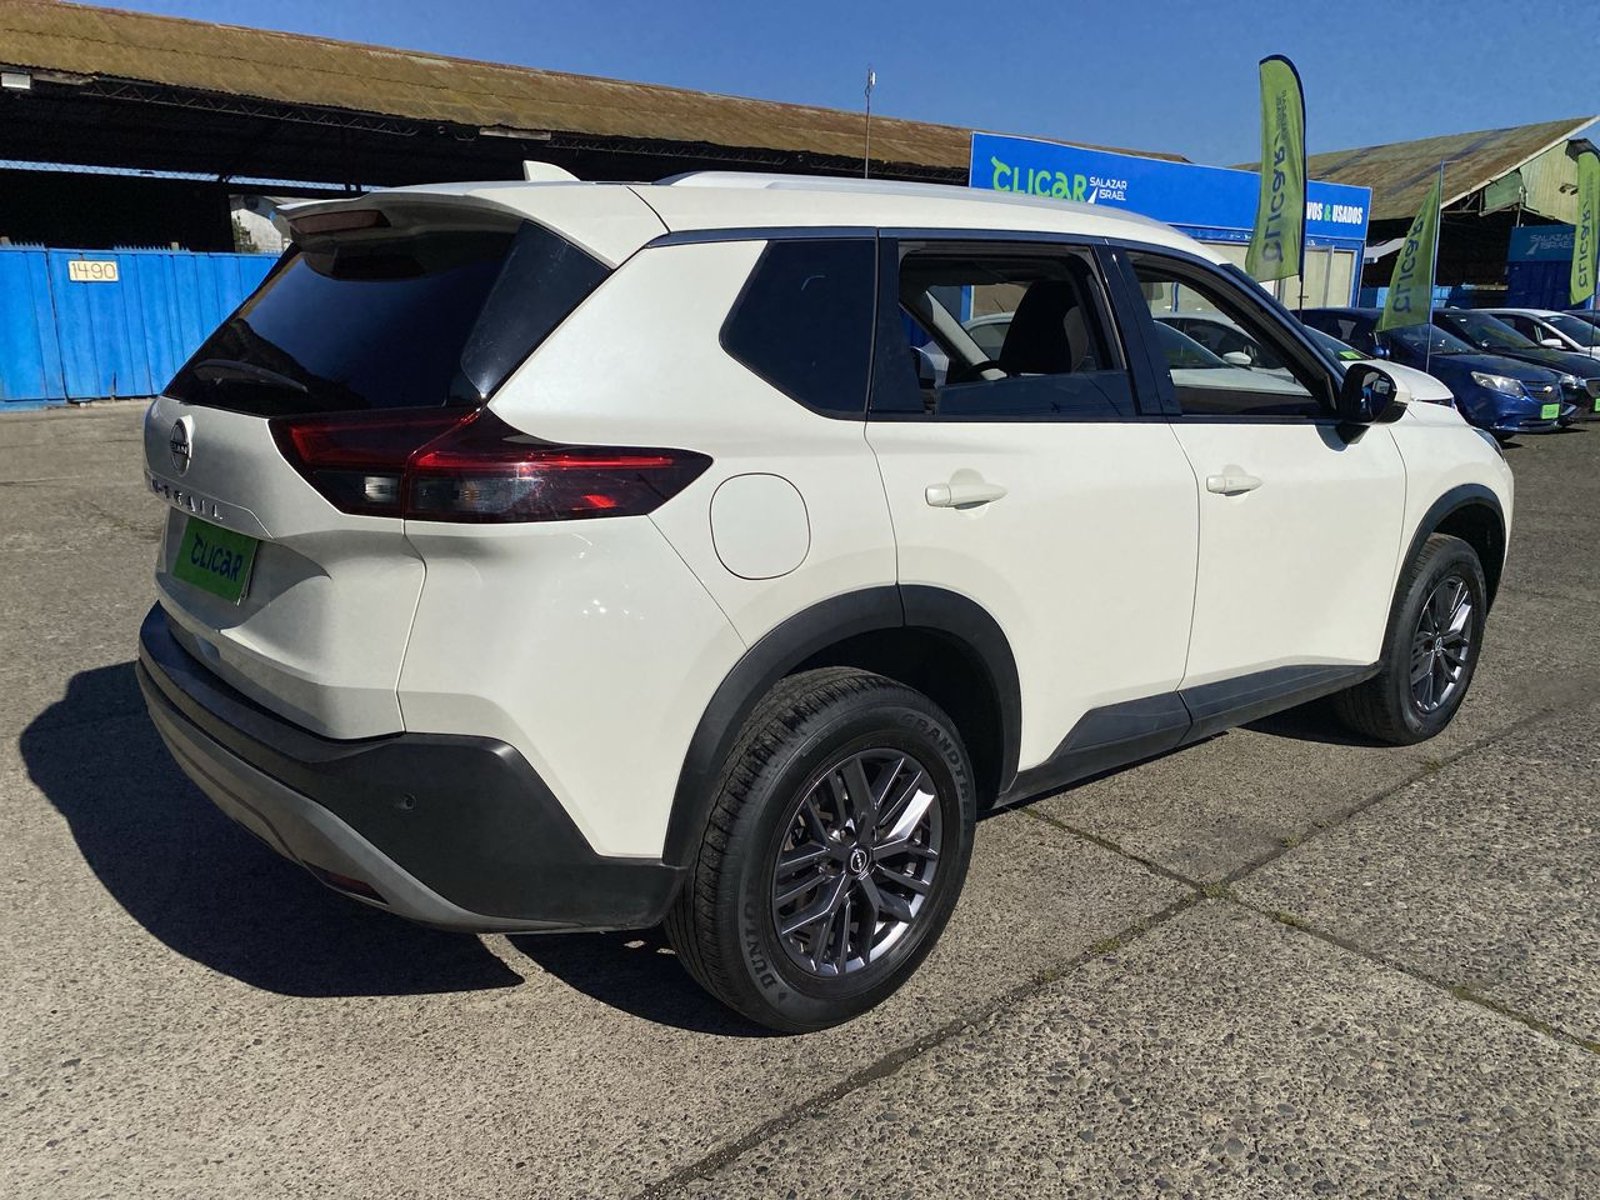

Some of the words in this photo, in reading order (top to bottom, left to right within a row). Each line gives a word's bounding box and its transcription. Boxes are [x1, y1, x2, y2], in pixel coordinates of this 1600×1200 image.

[1089, 176, 1127, 190] SALAZAR
[1098, 188, 1127, 201] ISRAEL
[1324, 204, 1331, 222] &
[1332, 204, 1363, 225] USADOS
[70, 262, 117, 279] 1490
